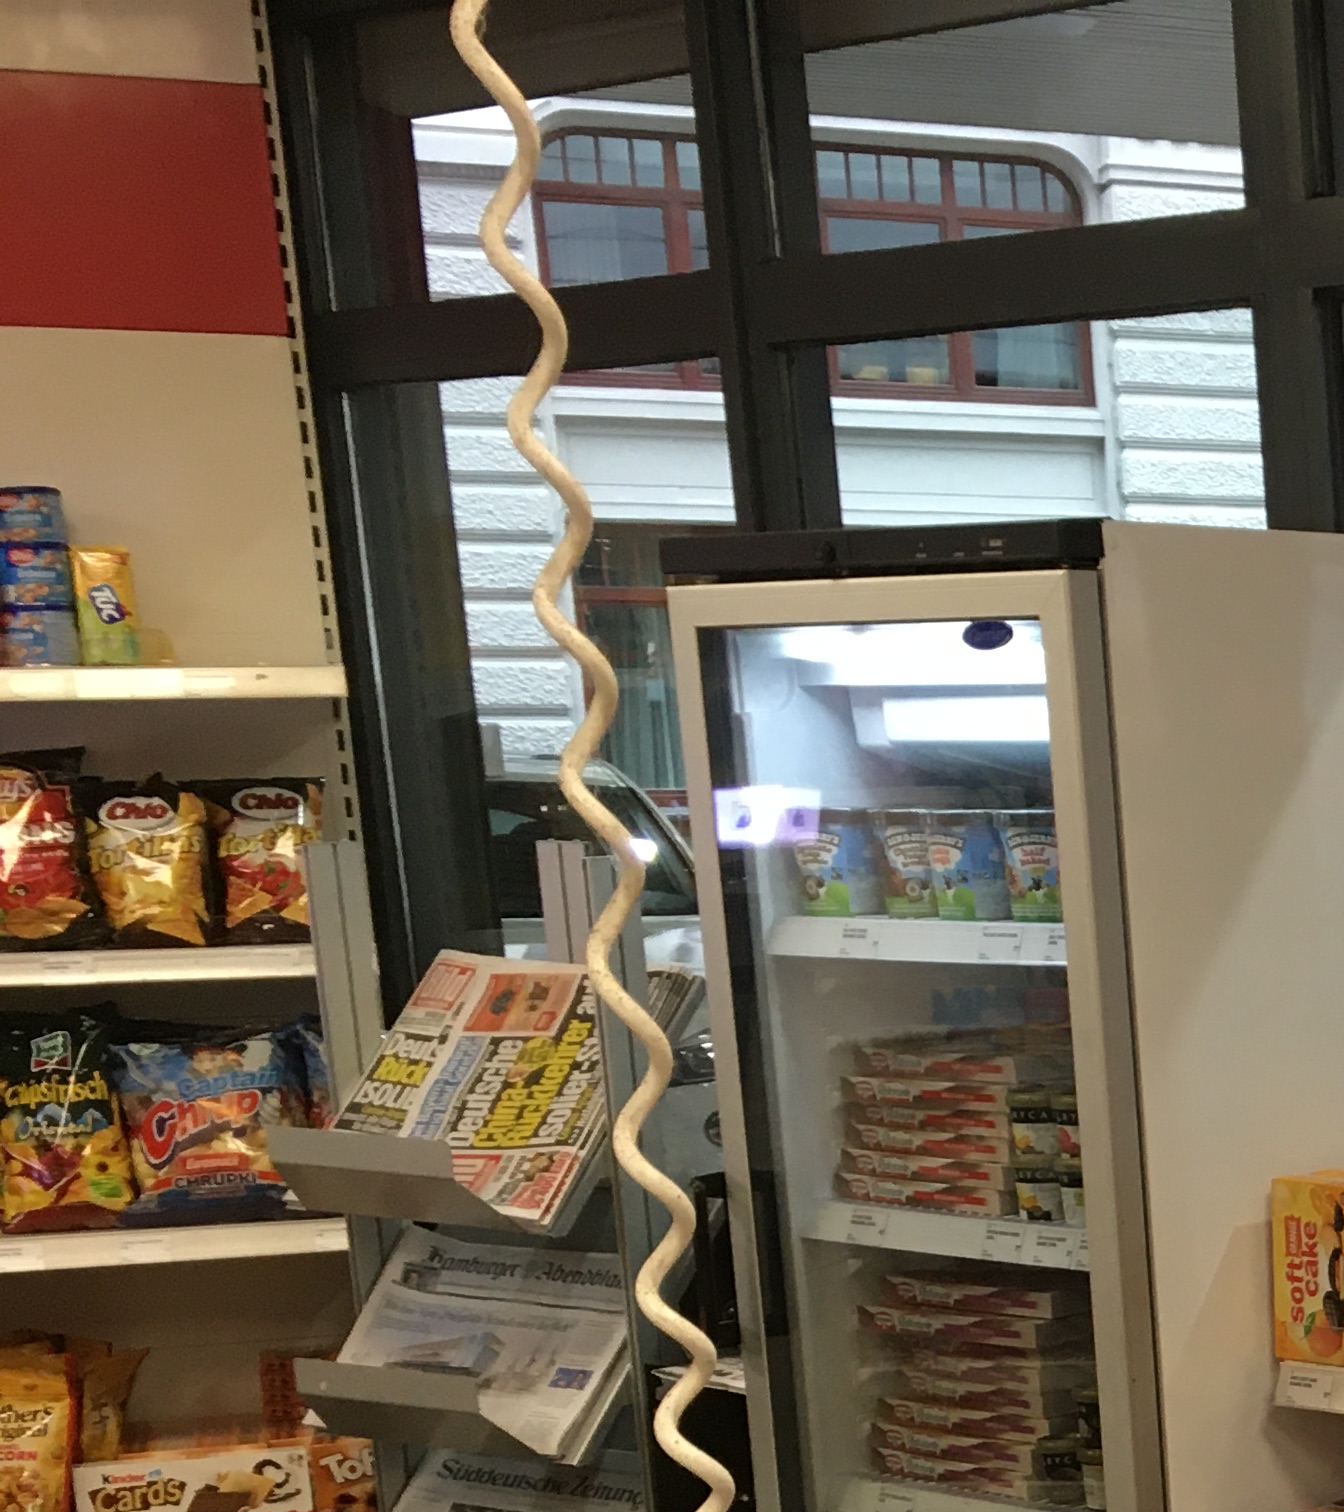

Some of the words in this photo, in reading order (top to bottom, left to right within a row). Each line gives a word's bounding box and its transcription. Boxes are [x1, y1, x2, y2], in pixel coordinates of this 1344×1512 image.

[90, 586, 122, 623] TUC
[105, 801, 169, 821] Chio
[239, 792, 301, 810] Chio
[445, 1038, 524, 1147] Deutsche
[424, 1245, 521, 1280] Hamburger
[1302, 1220, 1318, 1298] cake
[1285, 1252, 1305, 1324] soft
[436, 1458, 571, 1497] Süddeutsche
